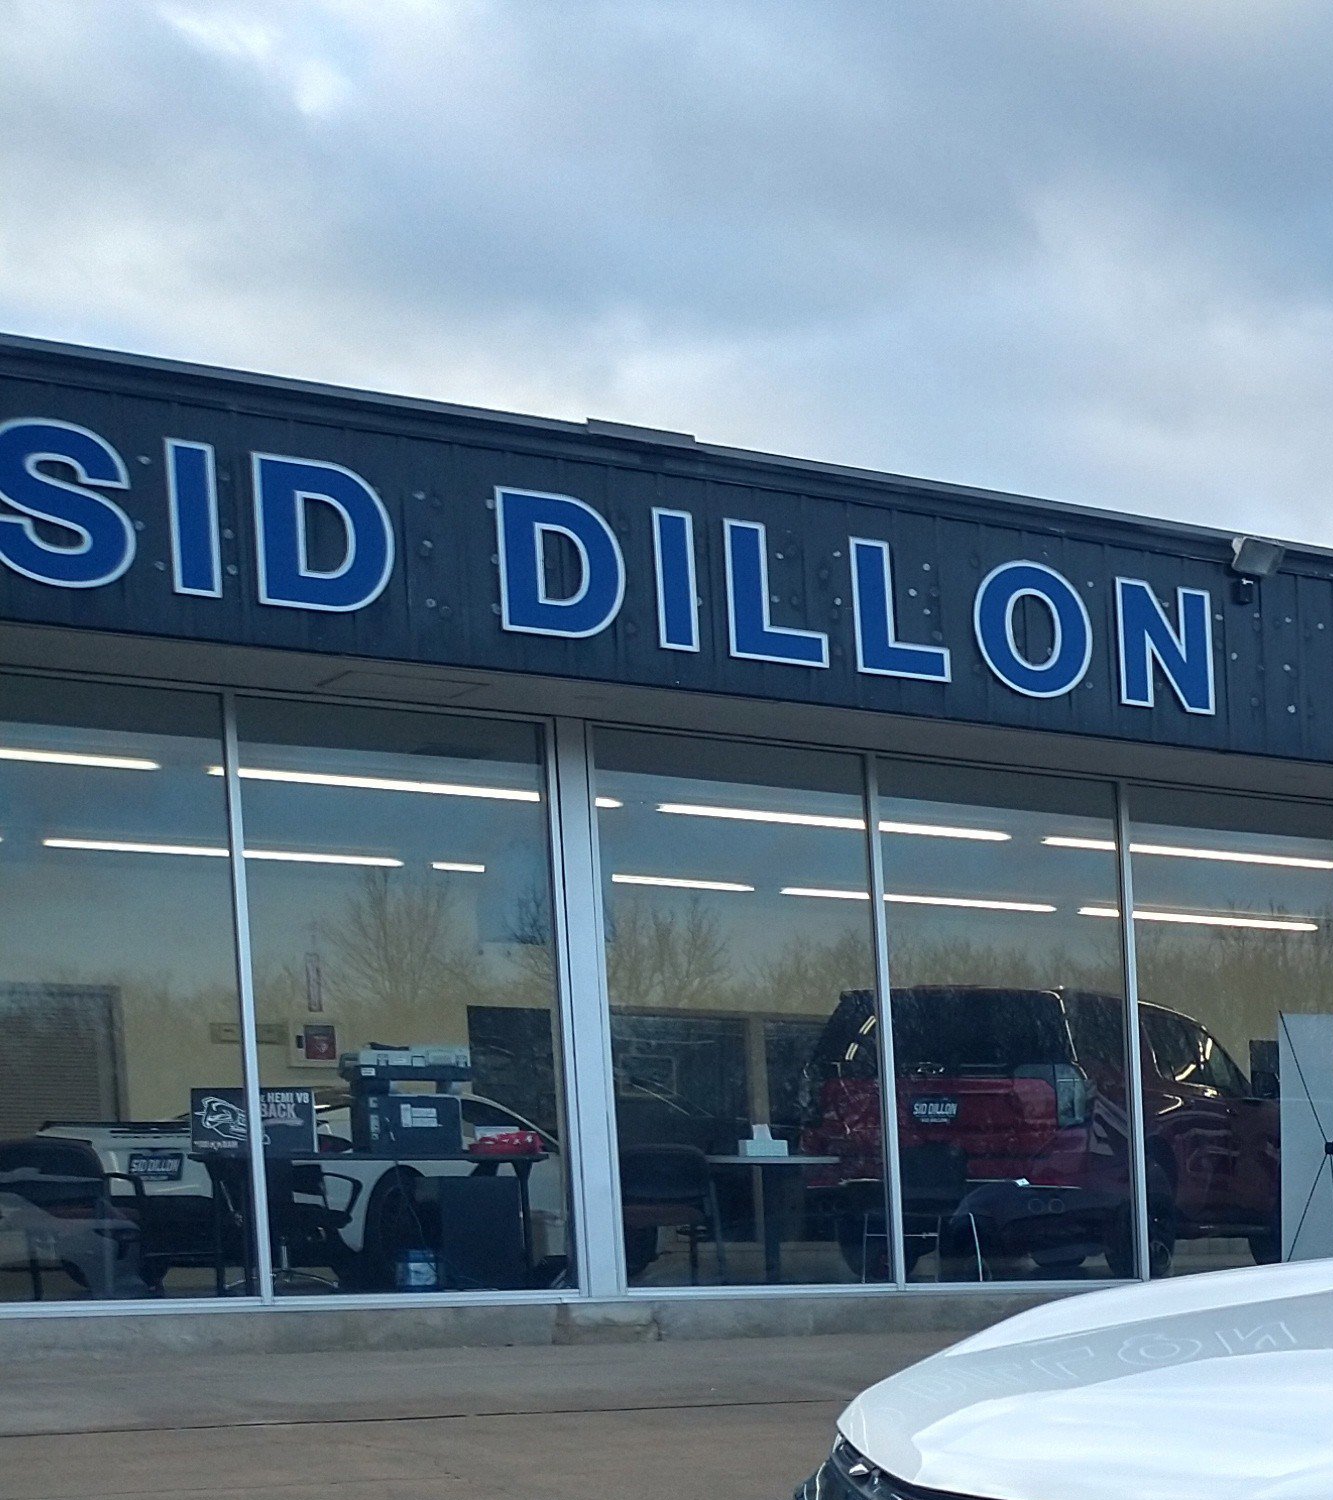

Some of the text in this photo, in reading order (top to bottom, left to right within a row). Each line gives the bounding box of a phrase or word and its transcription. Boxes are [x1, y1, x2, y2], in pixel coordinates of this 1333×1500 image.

[0, 416, 1217, 716] SID DILLON
[267, 1092, 294, 1103] HEMI
[913, 1103, 958, 1115] SID DILLON
